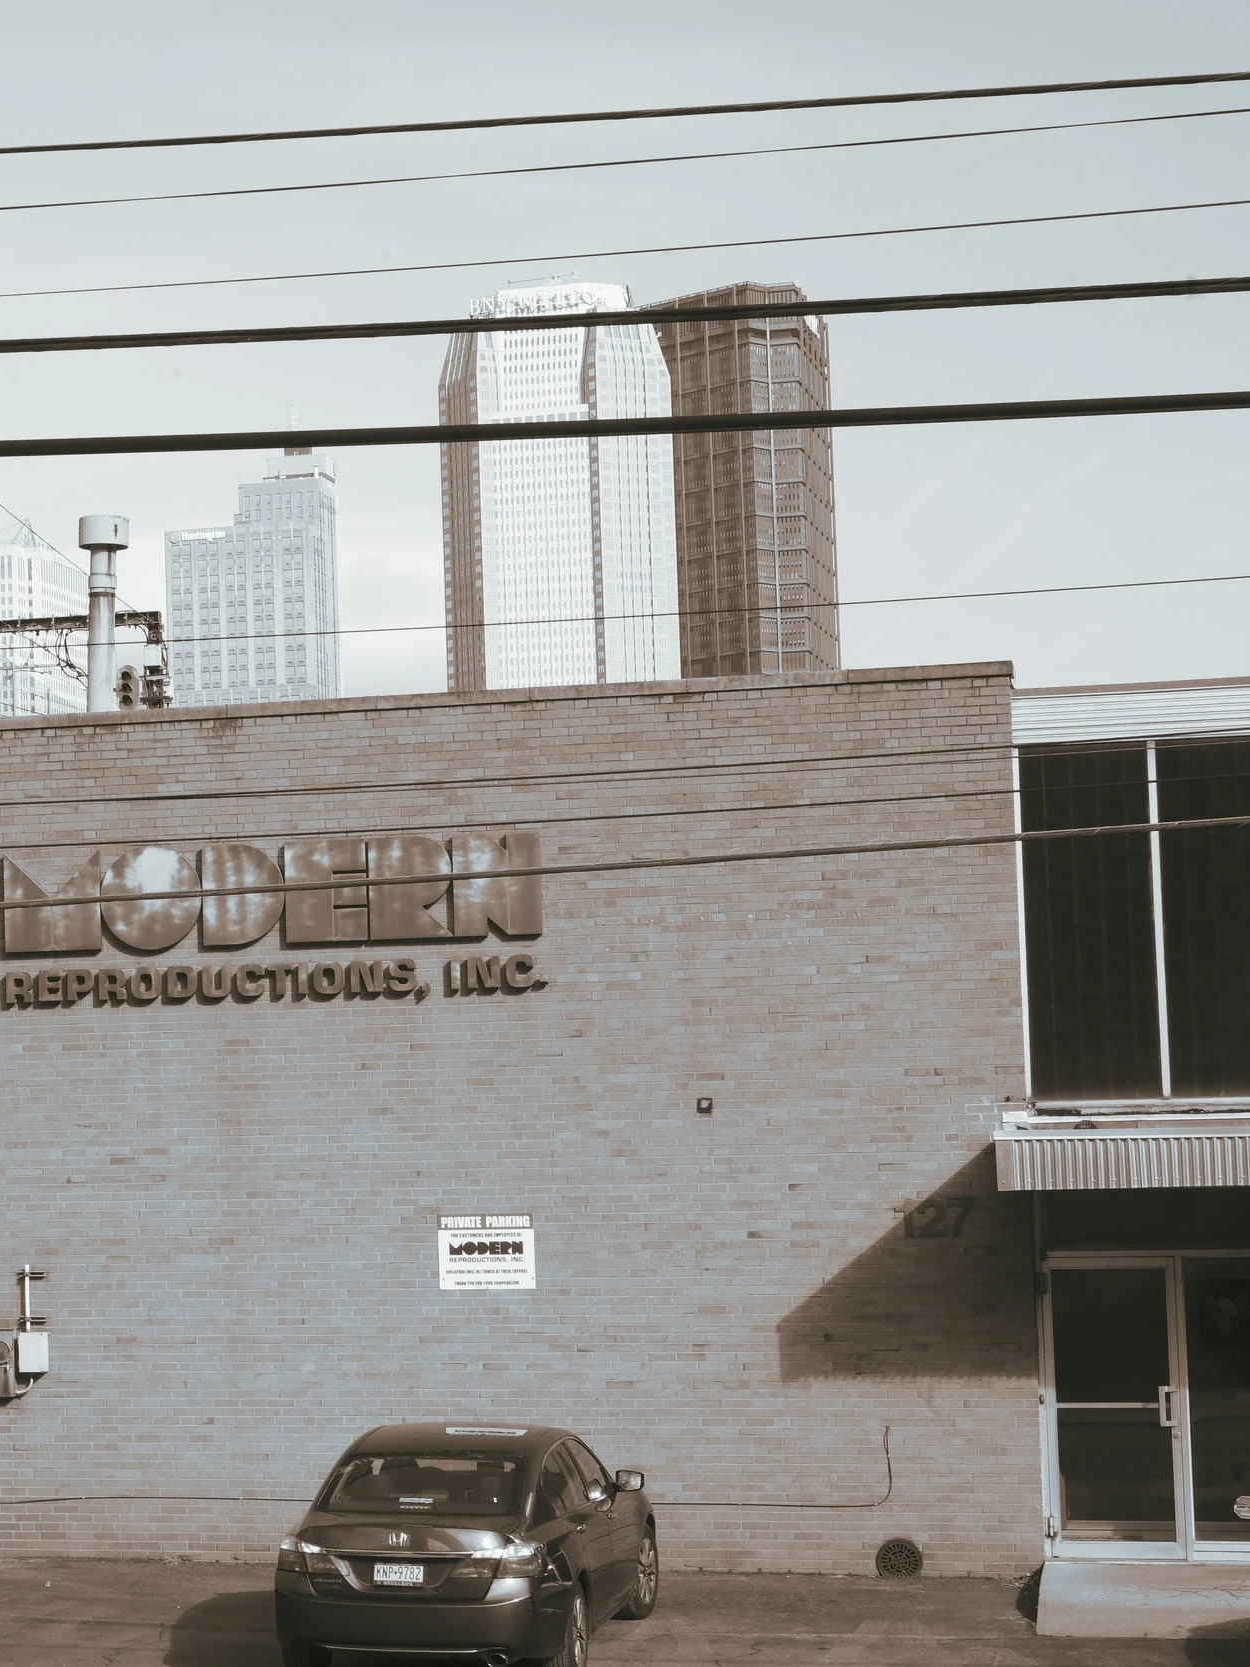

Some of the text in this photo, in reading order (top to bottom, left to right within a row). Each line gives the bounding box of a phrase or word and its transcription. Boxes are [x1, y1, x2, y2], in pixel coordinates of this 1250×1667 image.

[181, 531, 226, 542] Huntington
[1, 831, 543, 953] MODERN
[2, 954, 549, 1008] REPRODUCTIONS, INC.
[440, 1215, 531, 1229] PRIVATE PARKING
[894, 1196, 976, 1237] 127
[449, 1241, 524, 1255] MODERN
